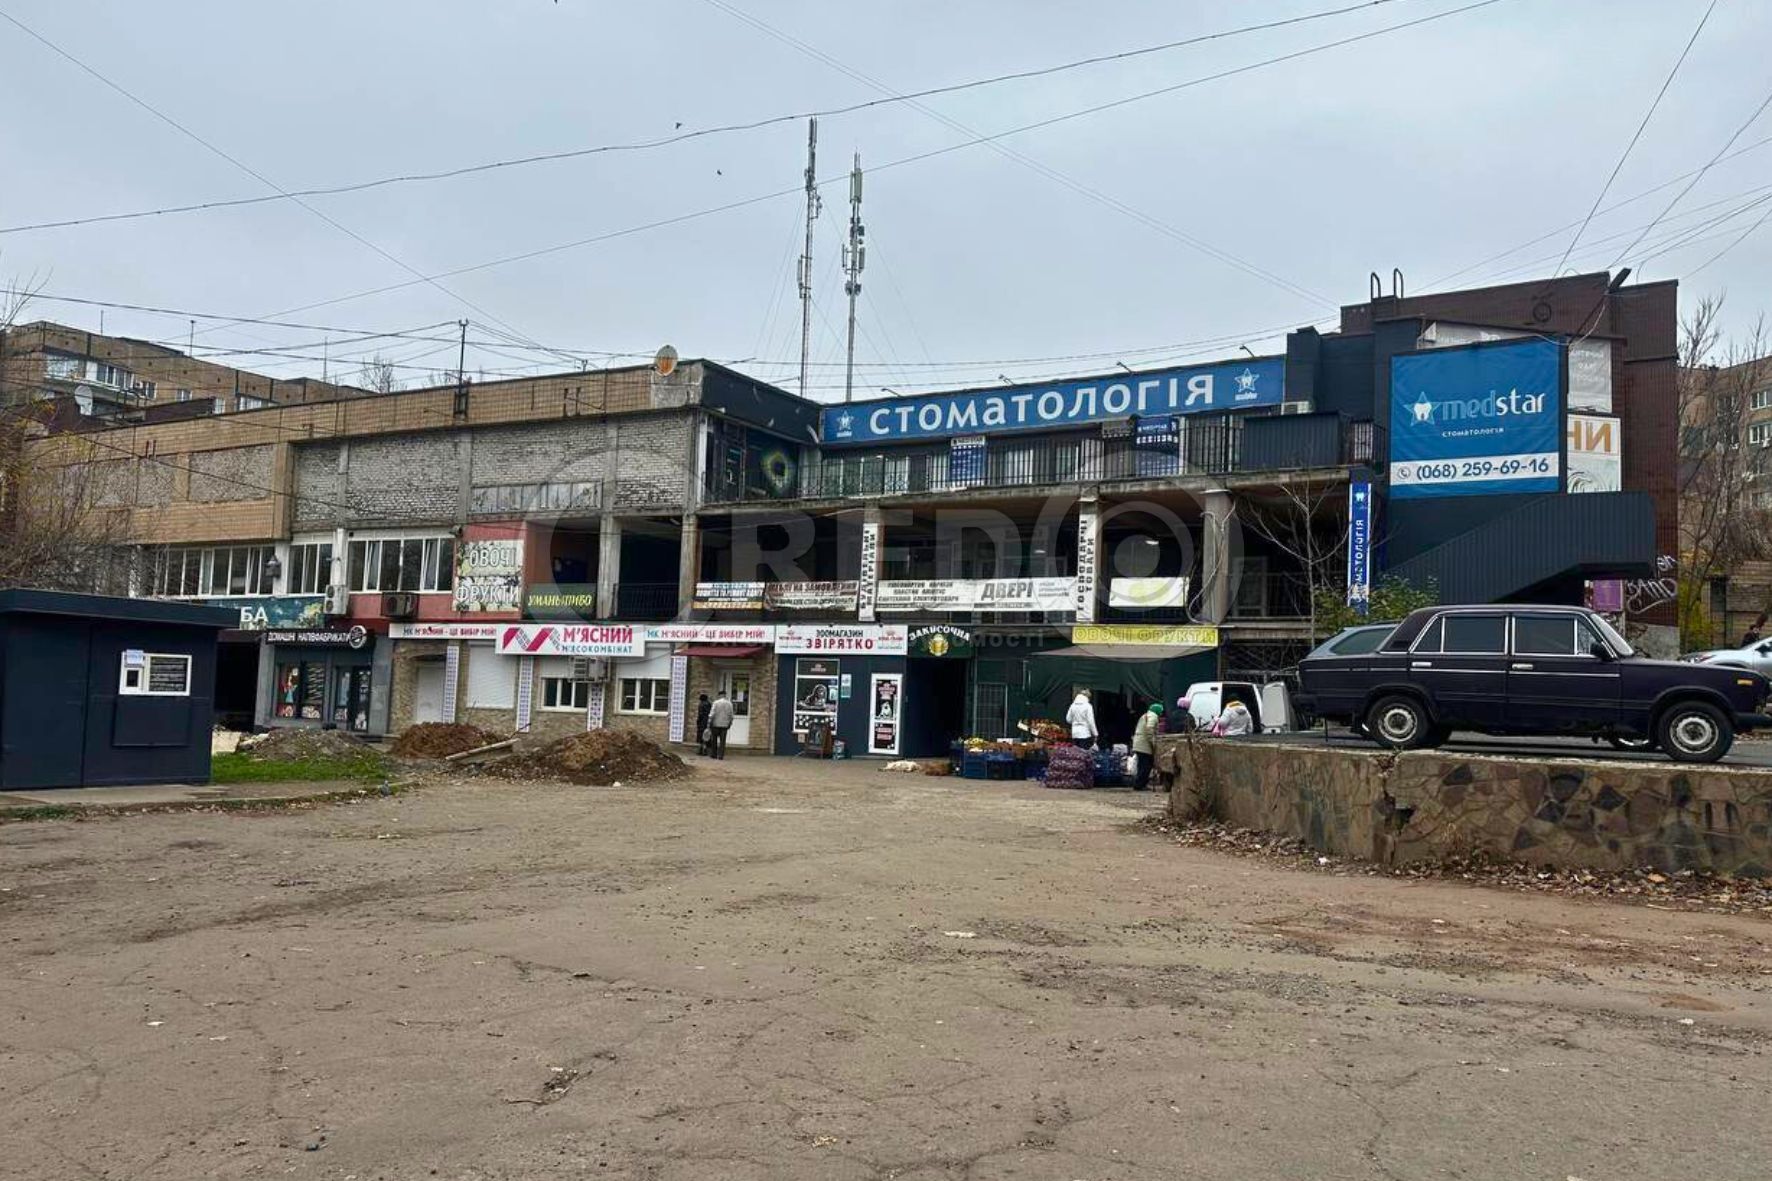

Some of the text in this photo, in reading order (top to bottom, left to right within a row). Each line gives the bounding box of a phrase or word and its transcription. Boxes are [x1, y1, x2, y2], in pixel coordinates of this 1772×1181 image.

[1442, 388, 1546, 421] medstar
[1416, 458, 1549, 480] (068) 259-69-16
[468, 547, 517, 568] ОВОЧІ
[1085, 537, 1095, 592] ТОВАРИ
[455, 584, 520, 605] ФРУКТИ
[980, 581, 1034, 601] ДВЕРІ
[563, 624, 633, 643] М'ЯСНИЙ
[816, 629, 864, 638] ЗООМАГАЗИН
[1074, 627, 1133, 642] ОВОЧІ
[806, 638, 874, 650] ЗВІРЯТКО
